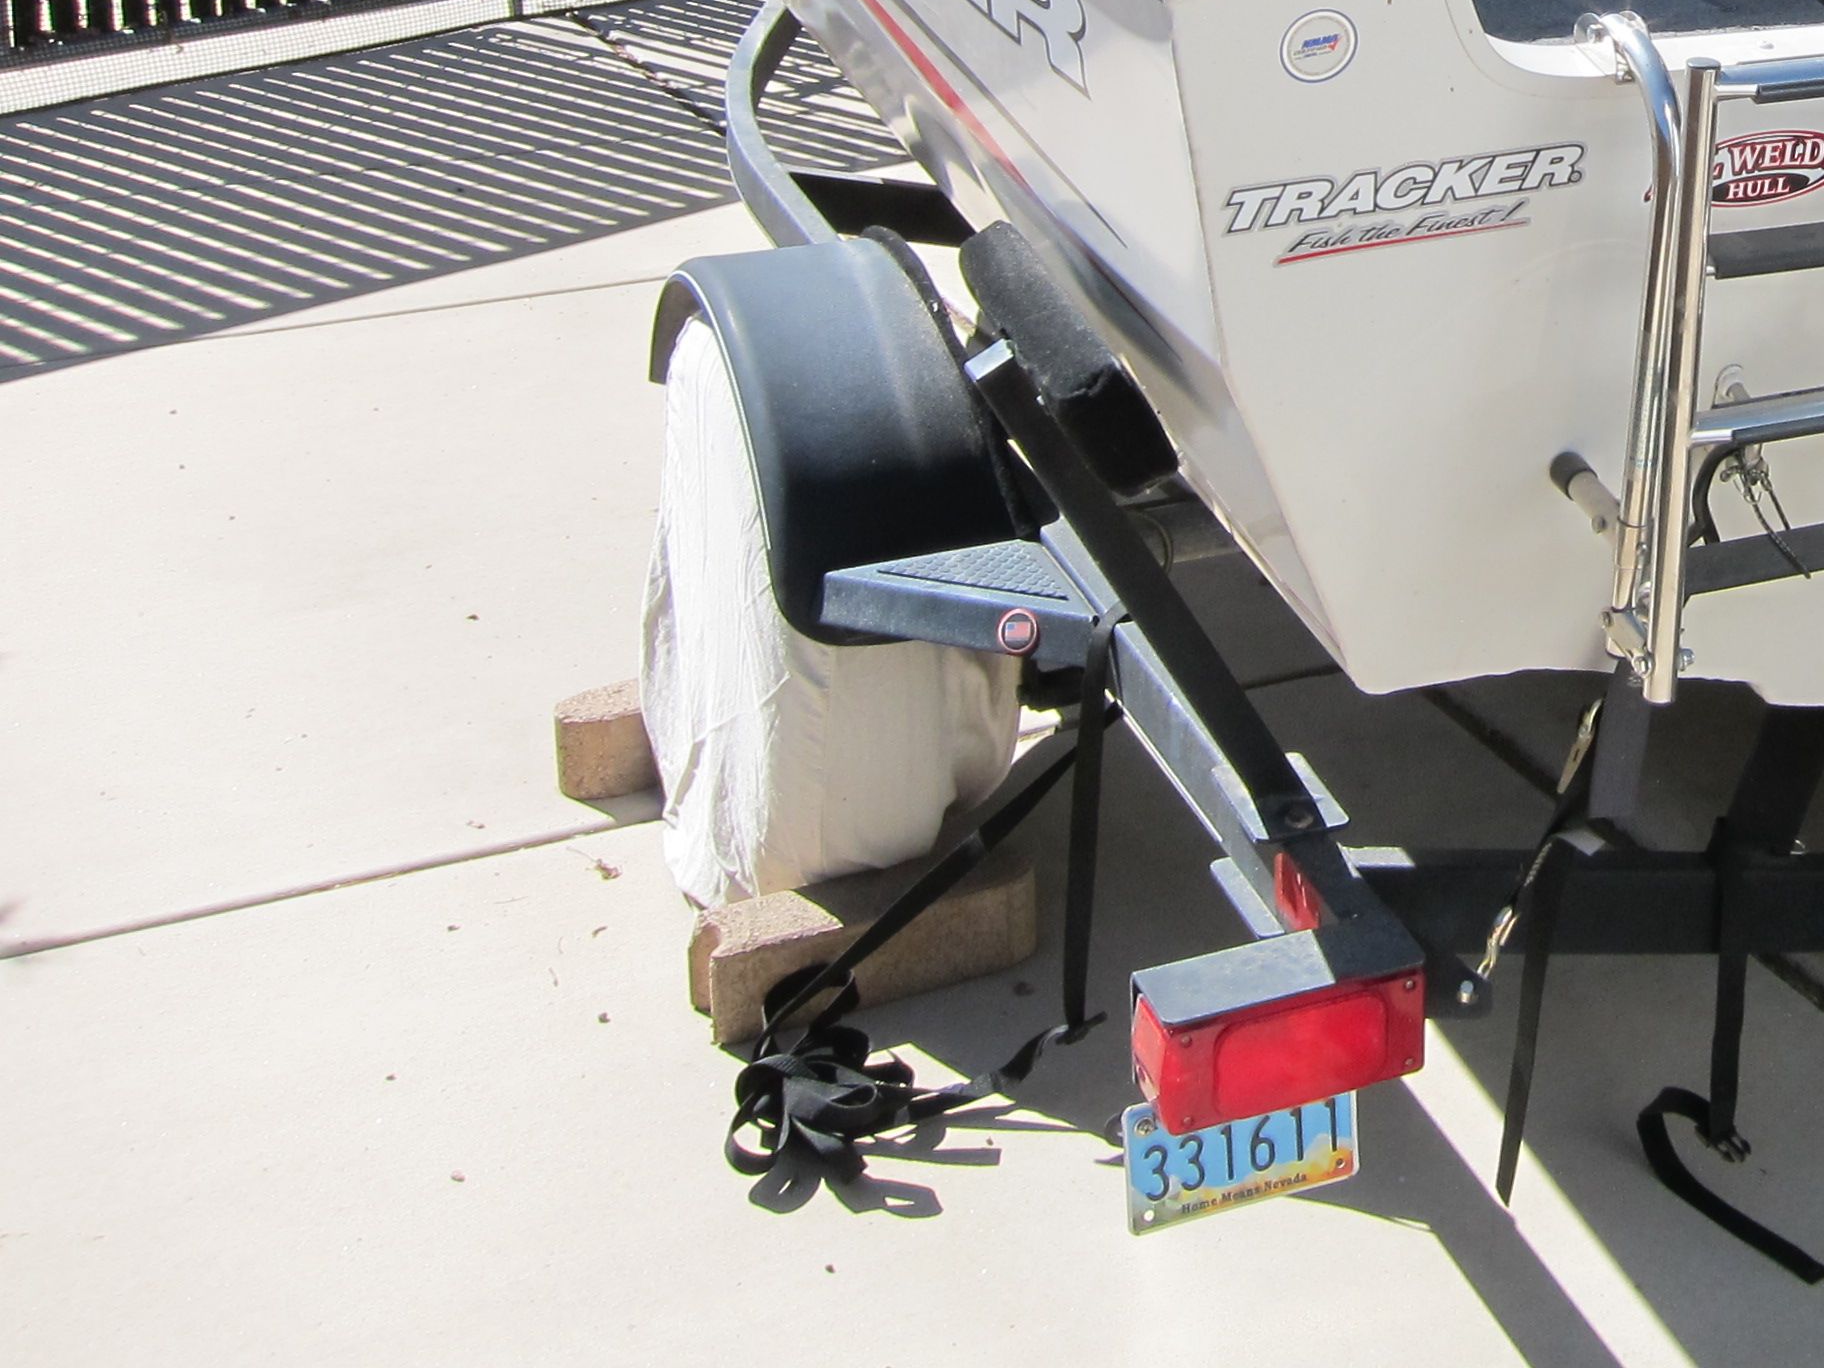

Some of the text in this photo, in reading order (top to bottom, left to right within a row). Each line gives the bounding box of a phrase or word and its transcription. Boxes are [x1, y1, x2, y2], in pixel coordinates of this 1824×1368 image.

[1226, 143, 1585, 233] TRACKER
[1726, 176, 1790, 200] HULL
[1288, 231, 1353, 253] Fish
[1358, 223, 1401, 244] the
[1142, 1097, 1339, 1202] 331611
[1181, 1172, 1308, 1214] Home Means Nevada
